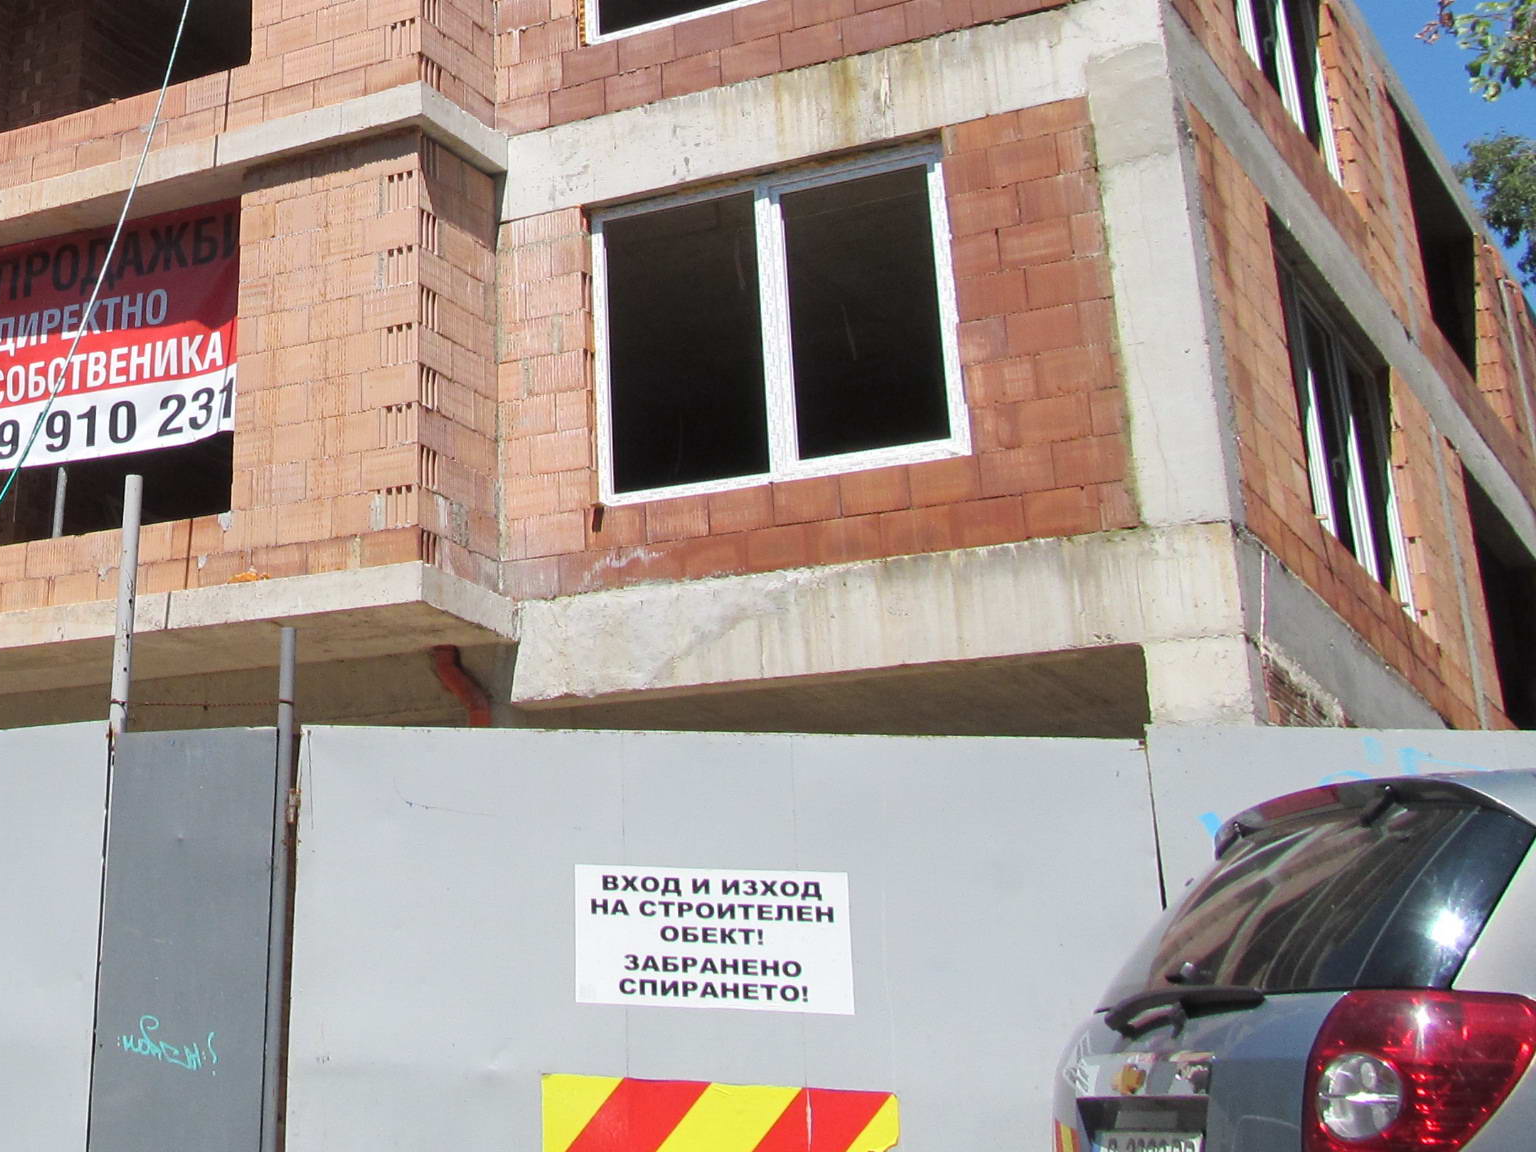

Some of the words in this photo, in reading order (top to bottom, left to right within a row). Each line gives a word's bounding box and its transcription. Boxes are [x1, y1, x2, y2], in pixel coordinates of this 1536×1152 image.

[46, 400, 136, 452] 910
[158, 377, 233, 438] 231
[601, 874, 682, 897] ВХОД
[691, 878, 711, 895] И
[721, 879, 823, 901] ИЗХОД
[590, 899, 630, 917] НА
[639, 900, 835, 924] СТРОИТЕЛЕН
[660, 925, 764, 946] ОБЕКТ!
[624, 954, 802, 978] ЗАБРАНЕНО
[619, 978, 809, 1003] СПИРАНЕТО!
